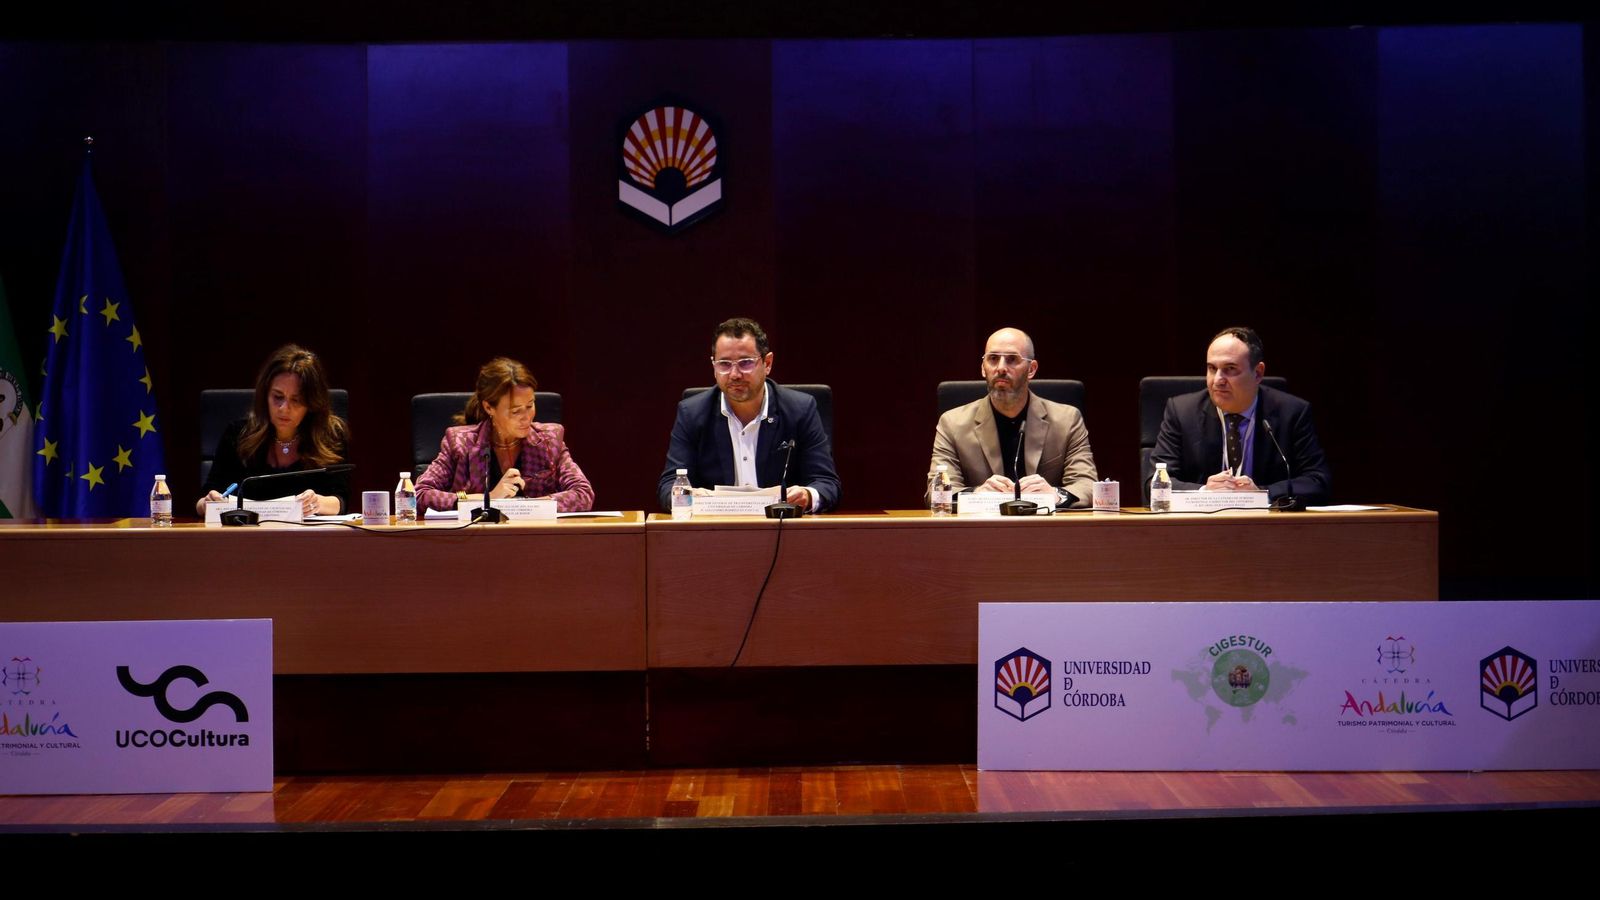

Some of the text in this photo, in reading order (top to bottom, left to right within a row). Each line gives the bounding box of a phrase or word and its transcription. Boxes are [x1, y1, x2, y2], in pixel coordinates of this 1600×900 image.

[1208, 635, 1272, 657] CIGESTUR
[1063, 661, 1151, 675] UNIVERSIDAD
[1063, 689, 1126, 707] CÓRDOBA
[1340, 690, 1453, 717] Andalucía
[115, 729, 250, 748] UCOCultura
